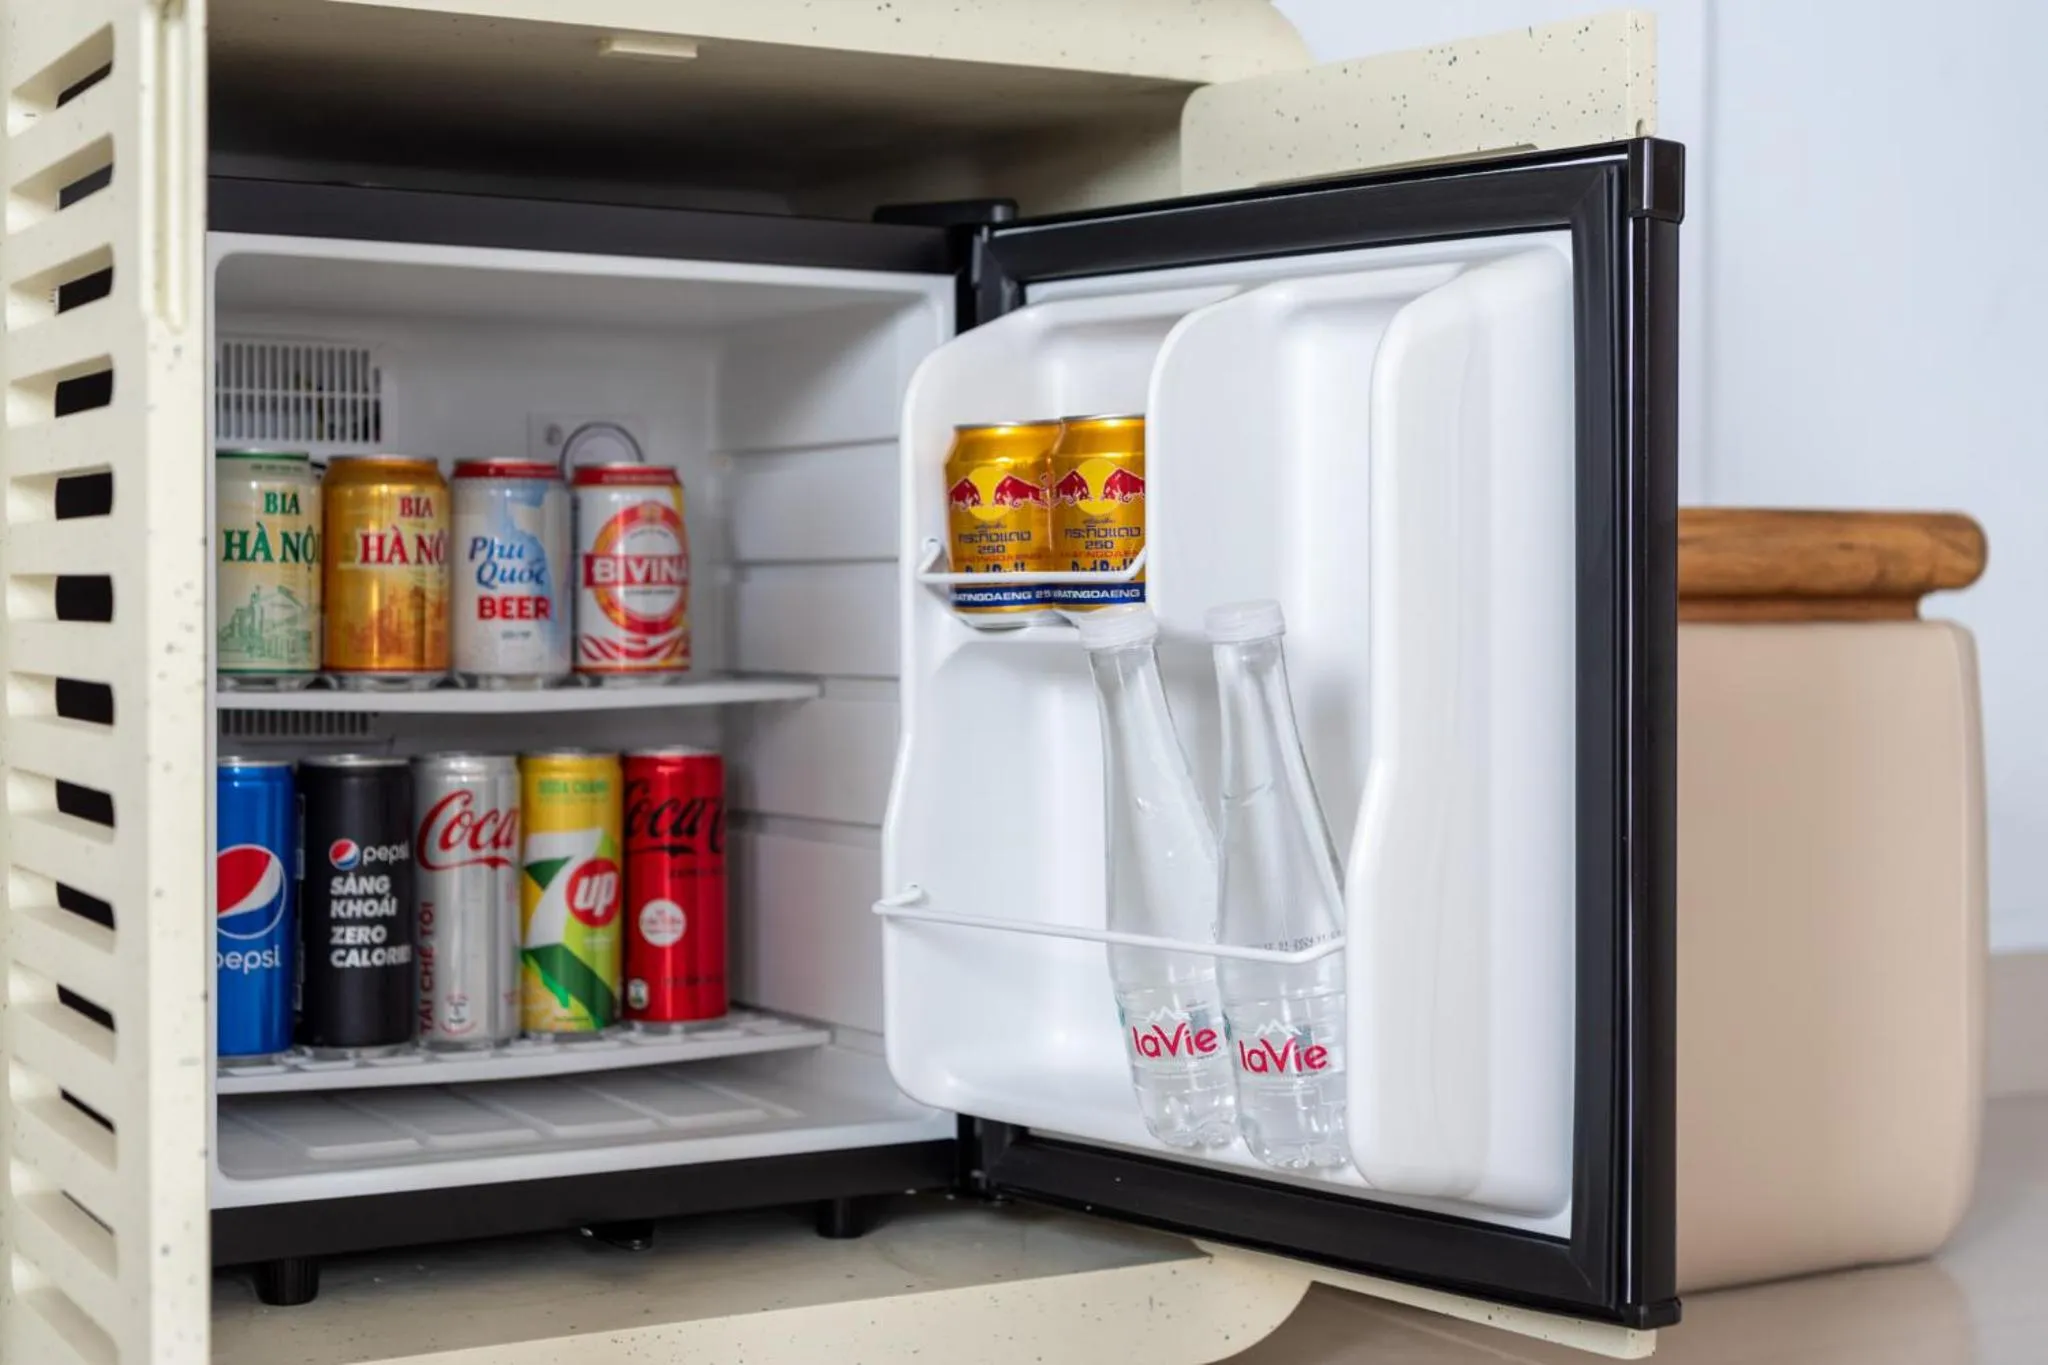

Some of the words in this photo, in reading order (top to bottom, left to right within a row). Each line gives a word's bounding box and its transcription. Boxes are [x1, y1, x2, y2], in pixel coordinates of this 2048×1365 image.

[264, 491, 302, 516] BIA
[399, 495, 434, 518] BIA
[222, 520, 275, 563] HÀ
[360, 523, 410, 566] HÀ
[977, 543, 1006, 555] 250
[1084, 540, 1115, 551] 250
[477, 594, 552, 622] BEER
[417, 789, 519, 871] Coca
[362, 841, 410, 867] pepsi
[329, 872, 391, 896] SÁNG
[329, 893, 398, 919] KHOÁI
[329, 923, 388, 946] ZERO
